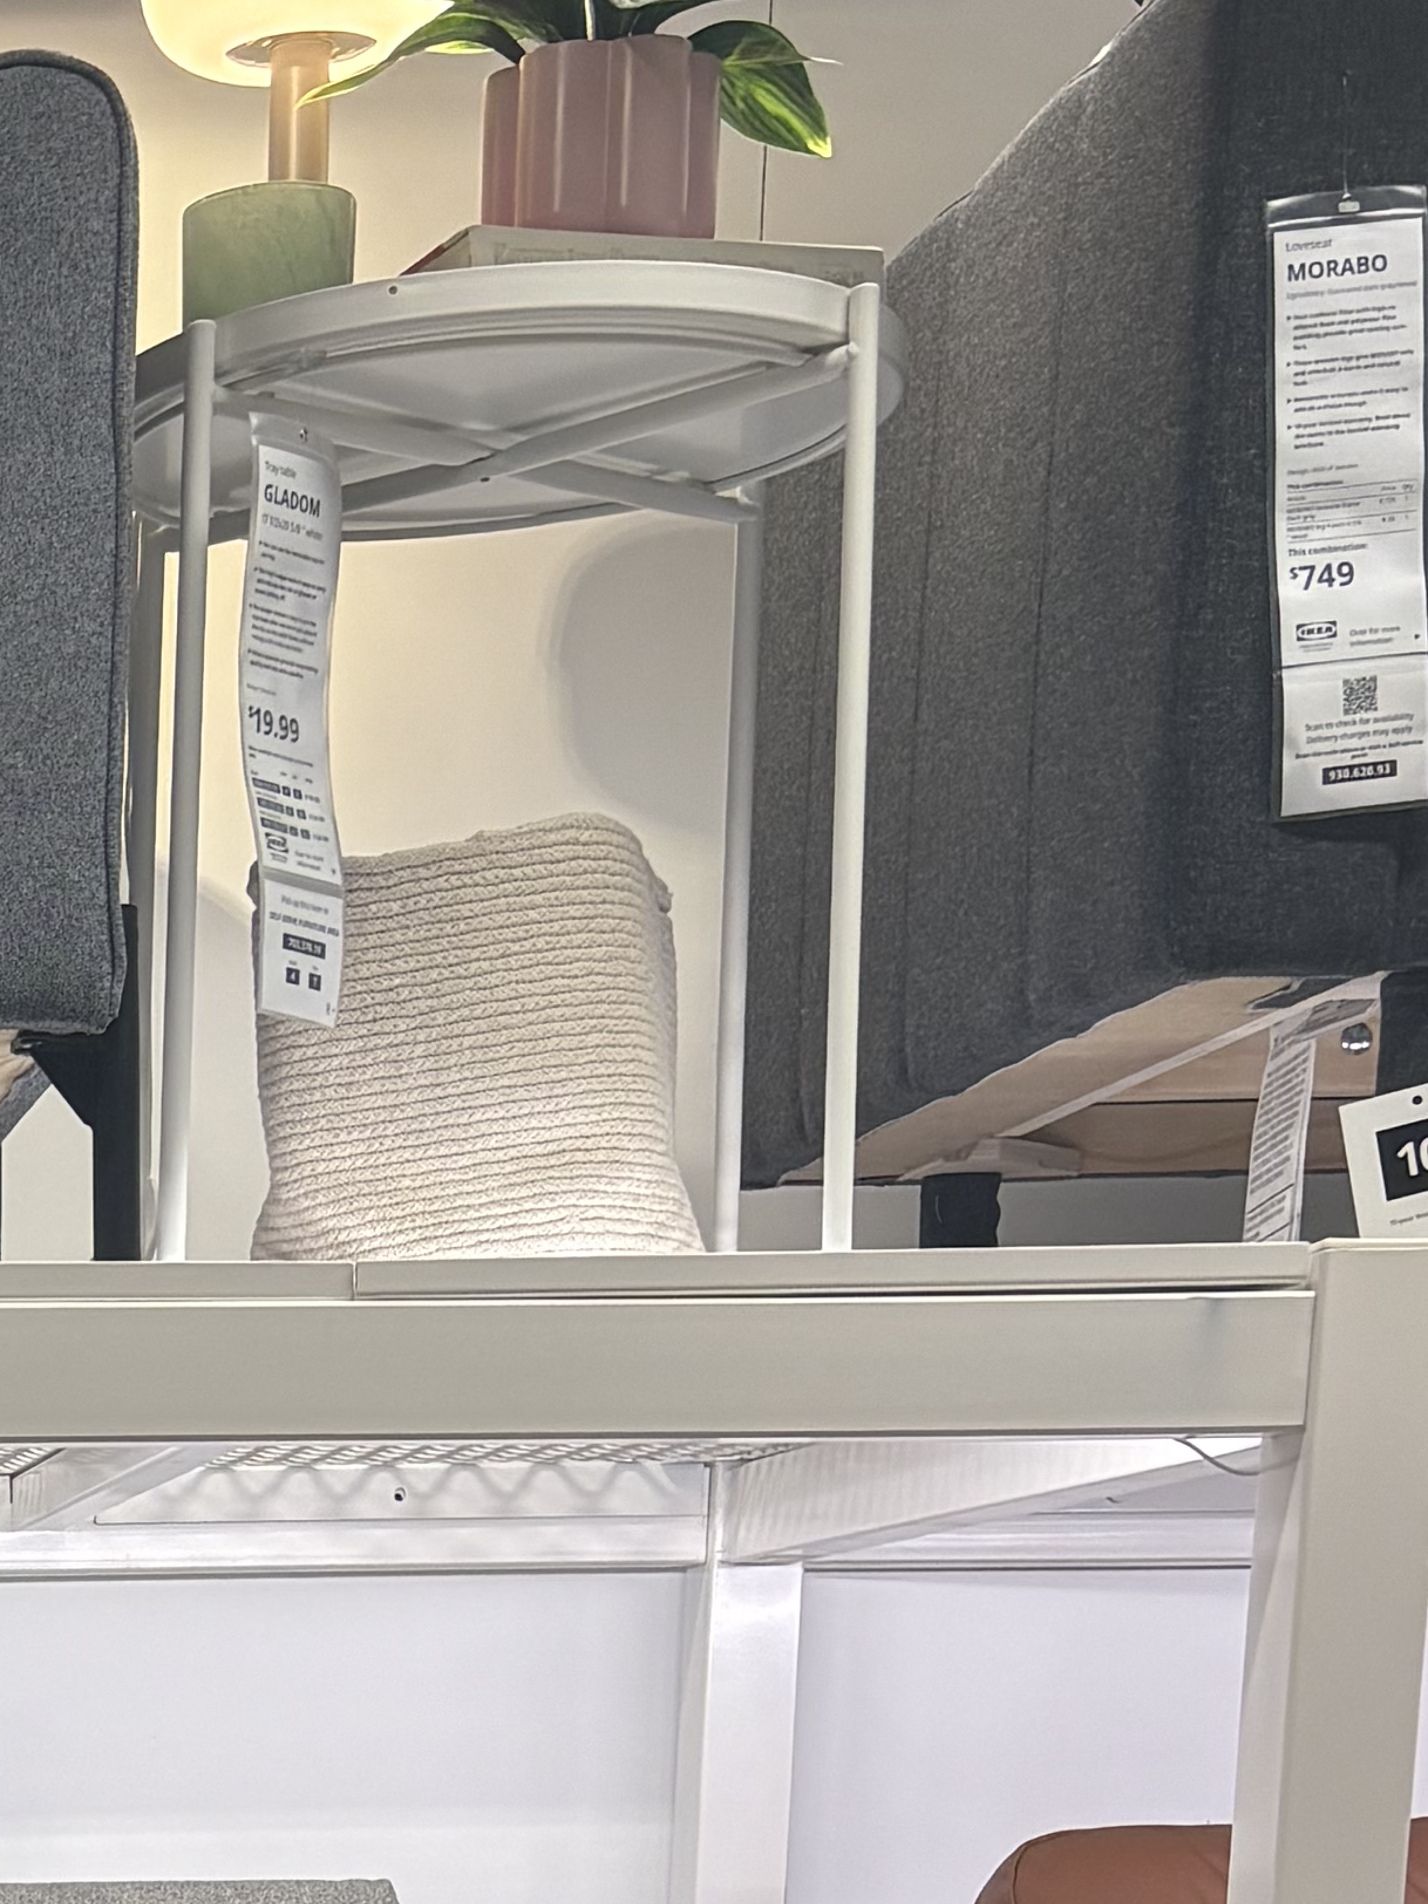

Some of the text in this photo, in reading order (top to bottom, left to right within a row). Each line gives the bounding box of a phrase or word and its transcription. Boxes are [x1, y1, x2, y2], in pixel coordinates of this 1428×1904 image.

[1287, 253, 1388, 282] MORABO
[264, 483, 321, 518] GLADOM
[1289, 561, 1355, 591] $749
[248, 704, 300, 743] $19.99
